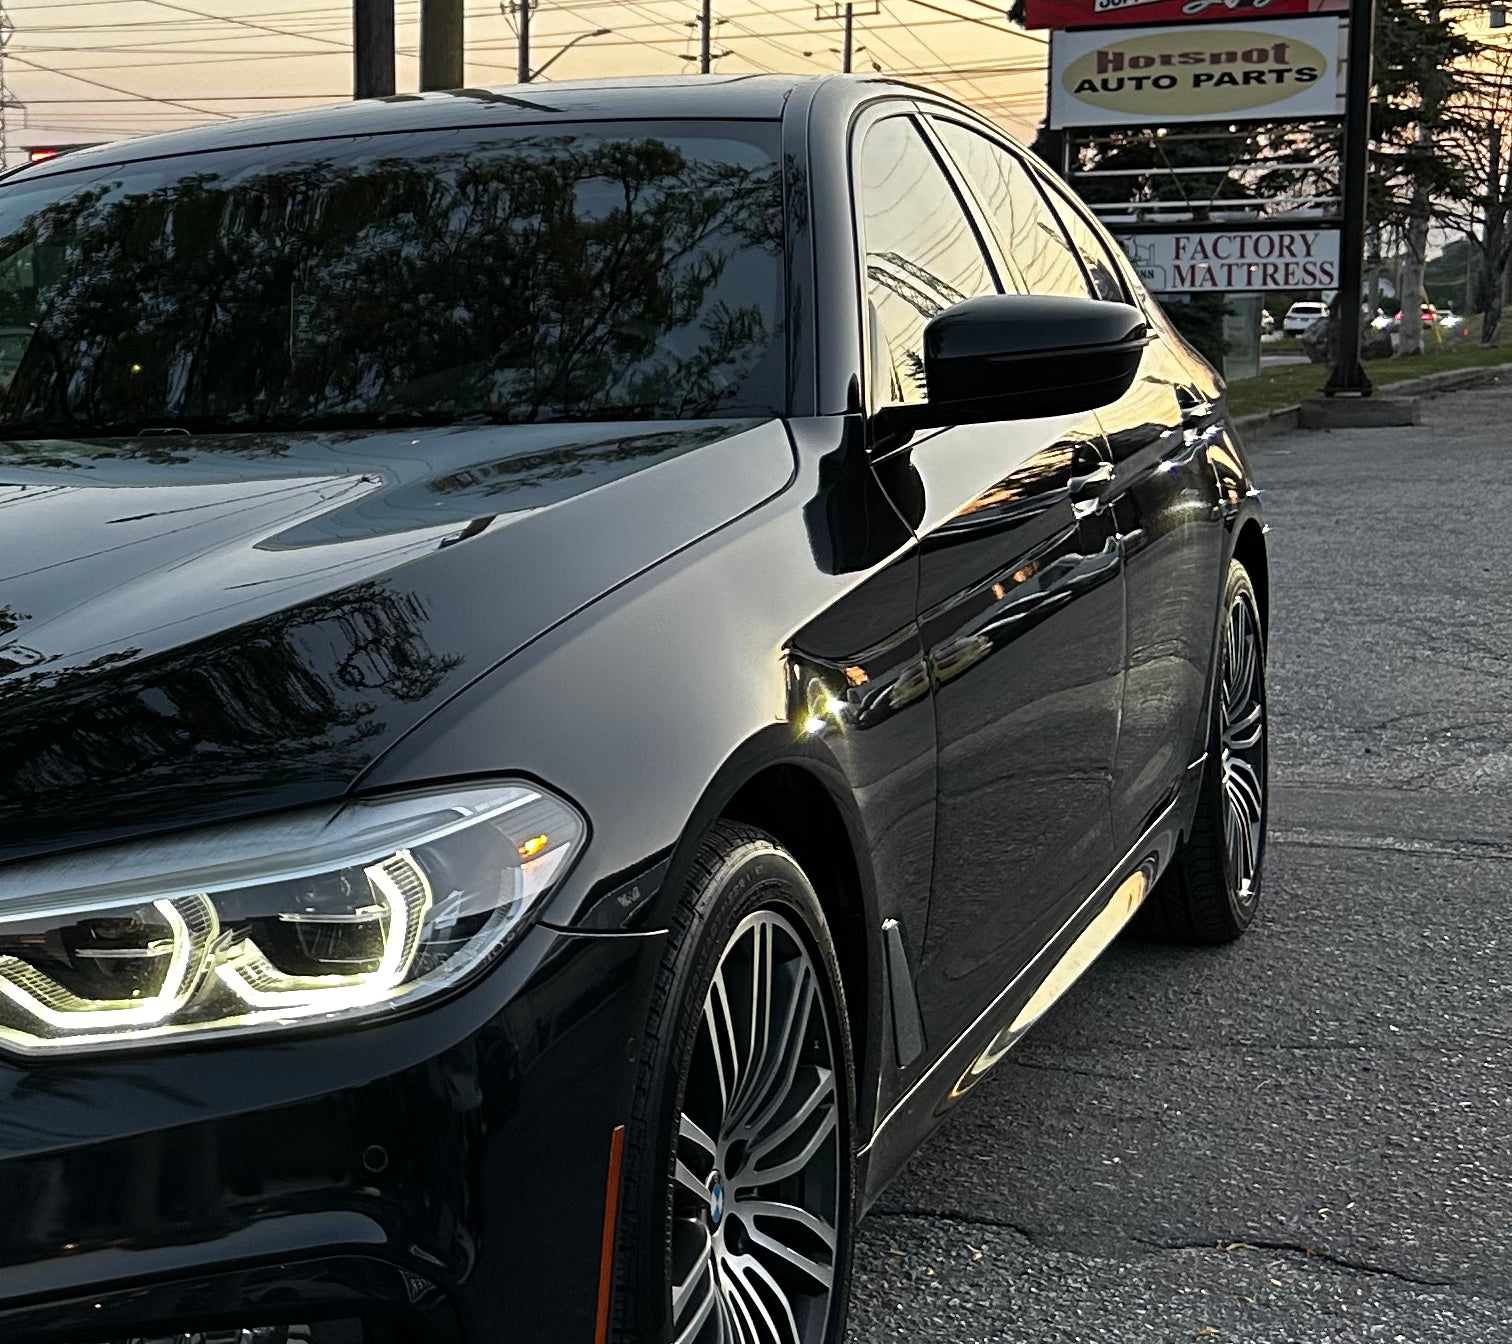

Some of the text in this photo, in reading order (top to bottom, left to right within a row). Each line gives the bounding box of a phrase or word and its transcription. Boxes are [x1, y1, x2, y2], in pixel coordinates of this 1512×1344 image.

[1073, 67, 1318, 94] AUTO PARTS
[1172, 233, 1320, 260] FACTORY
[1172, 260, 1335, 289] MATTRESS
